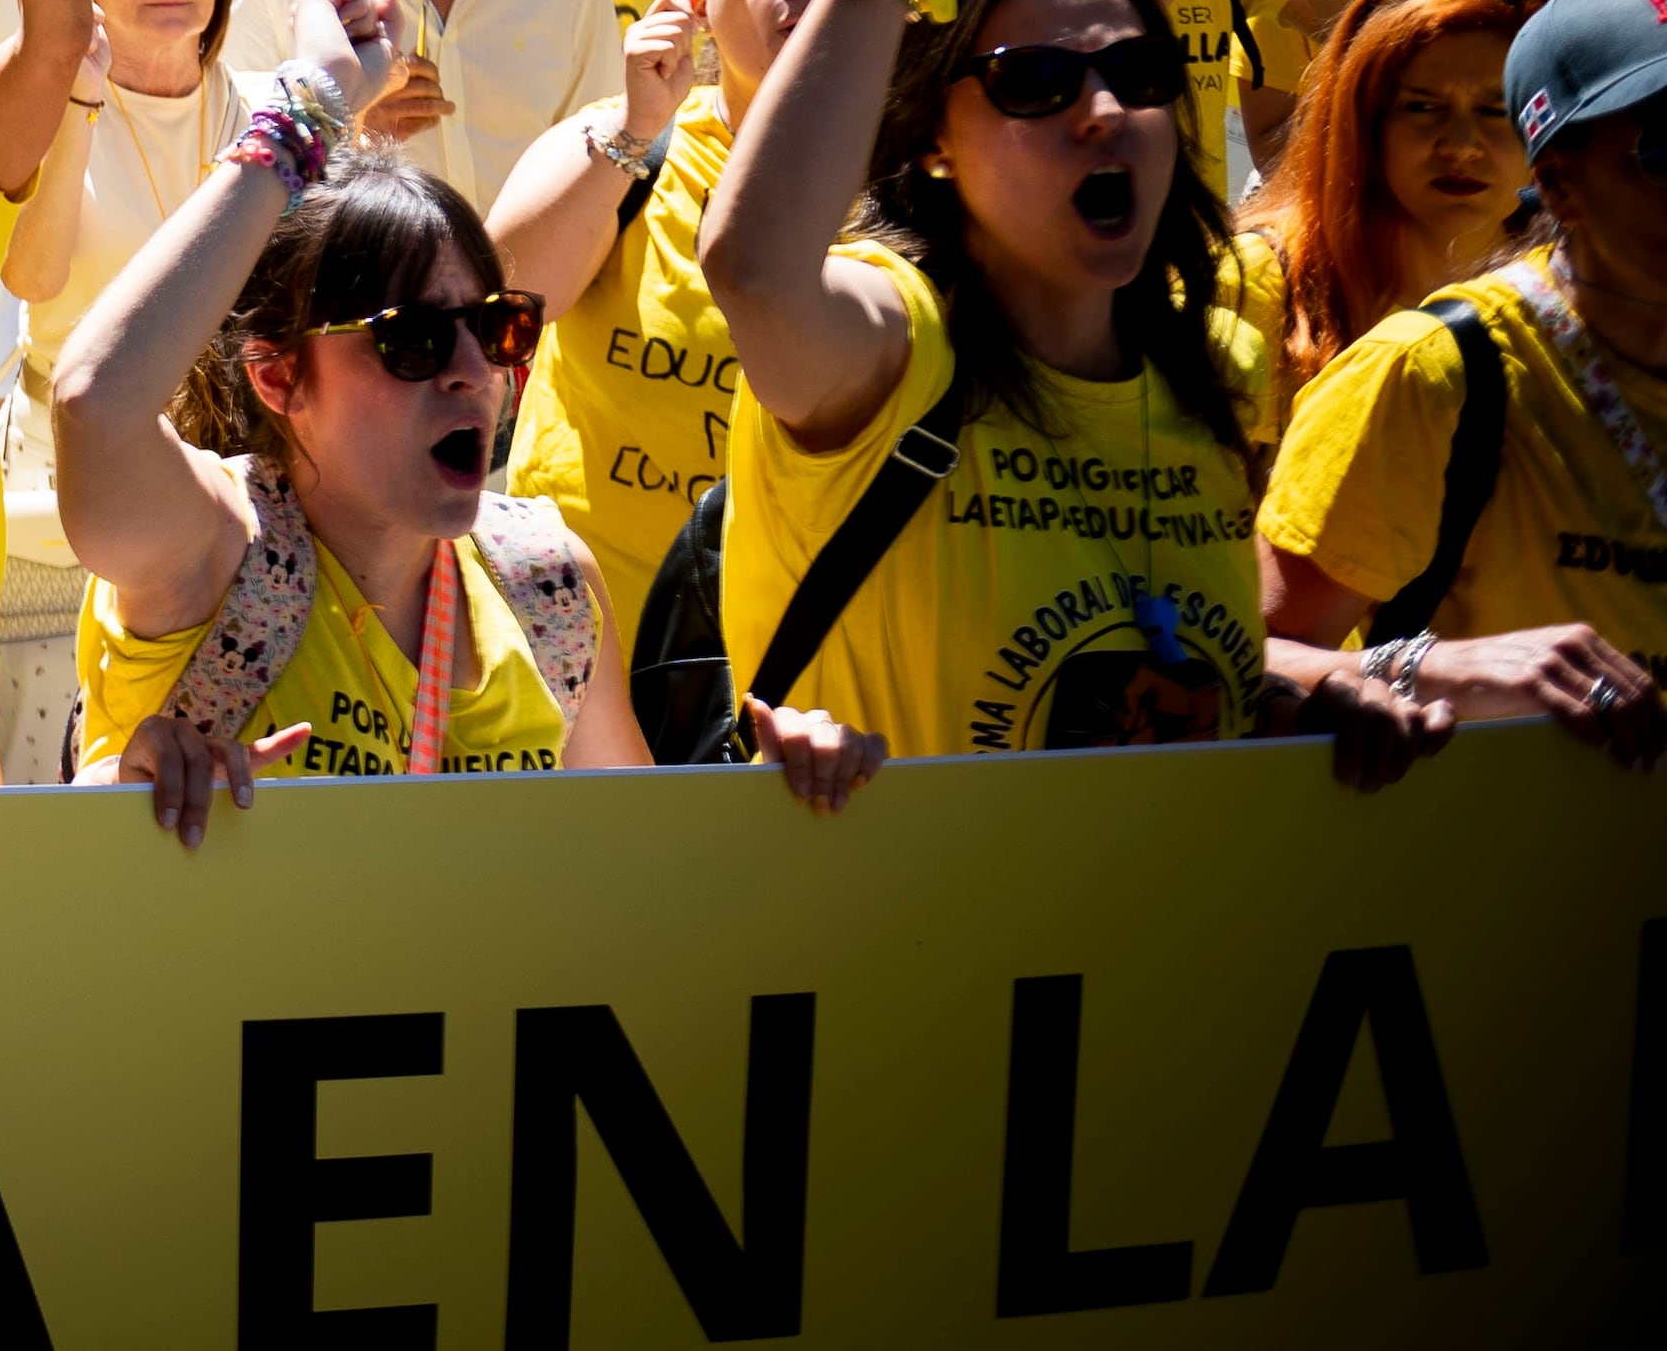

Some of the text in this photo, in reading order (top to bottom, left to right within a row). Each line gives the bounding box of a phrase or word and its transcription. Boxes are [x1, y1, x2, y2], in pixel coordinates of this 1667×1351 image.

[1177, 7, 1214, 24] SER
[606, 326, 740, 396] EDUC
[983, 574, 1115, 691] LABORAL
[1108, 570, 1147, 609] DE
[331, 689, 391, 746] POR
[234, 1009, 818, 1351] EN
[992, 942, 1492, 1320] LA
